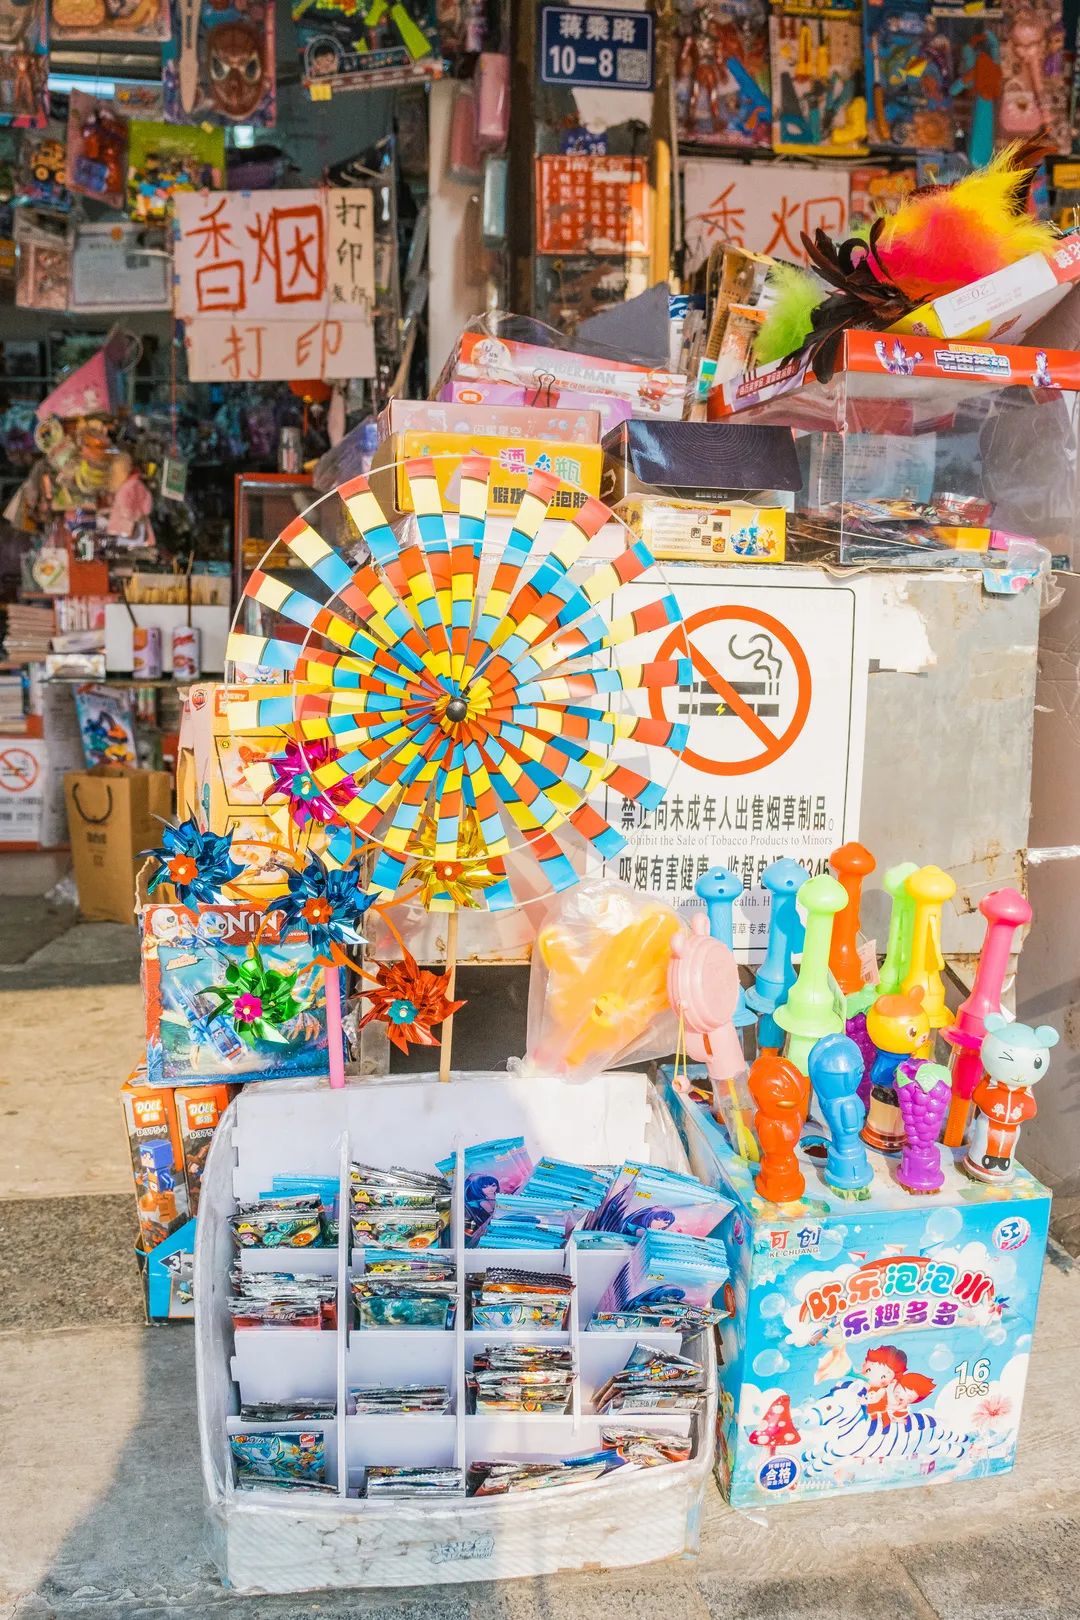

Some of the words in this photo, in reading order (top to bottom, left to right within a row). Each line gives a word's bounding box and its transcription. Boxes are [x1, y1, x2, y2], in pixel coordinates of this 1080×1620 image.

[699, 183, 846, 264] 香烟
[335, 196, 366, 281] 打印
[184, 198, 325, 312] 香烟
[222, 320, 342, 380] 打印
[620, 834, 659, 847] ohibit
[660, 834, 674, 847] the
[677, 834, 694, 847] Sale
[698, 834, 708, 847] of
[711, 834, 748, 847] Tobacco
[751, 834, 789, 847] Products
[791, 834, 799, 847] to
[802, 834, 834, 847] Minors
[734, 896, 760, 907] ealth.
[732, 922, 770, 935] 草专卖
[770, 1227, 822, 1249] 可创
[169, 1255, 180, 1270] 3
[843, 1300, 958, 1337] 乐趣多多
[955, 1357, 991, 1384] 16
[954, 1382, 989, 1400] PCS
[765, 1468, 791, 1481] 合格
